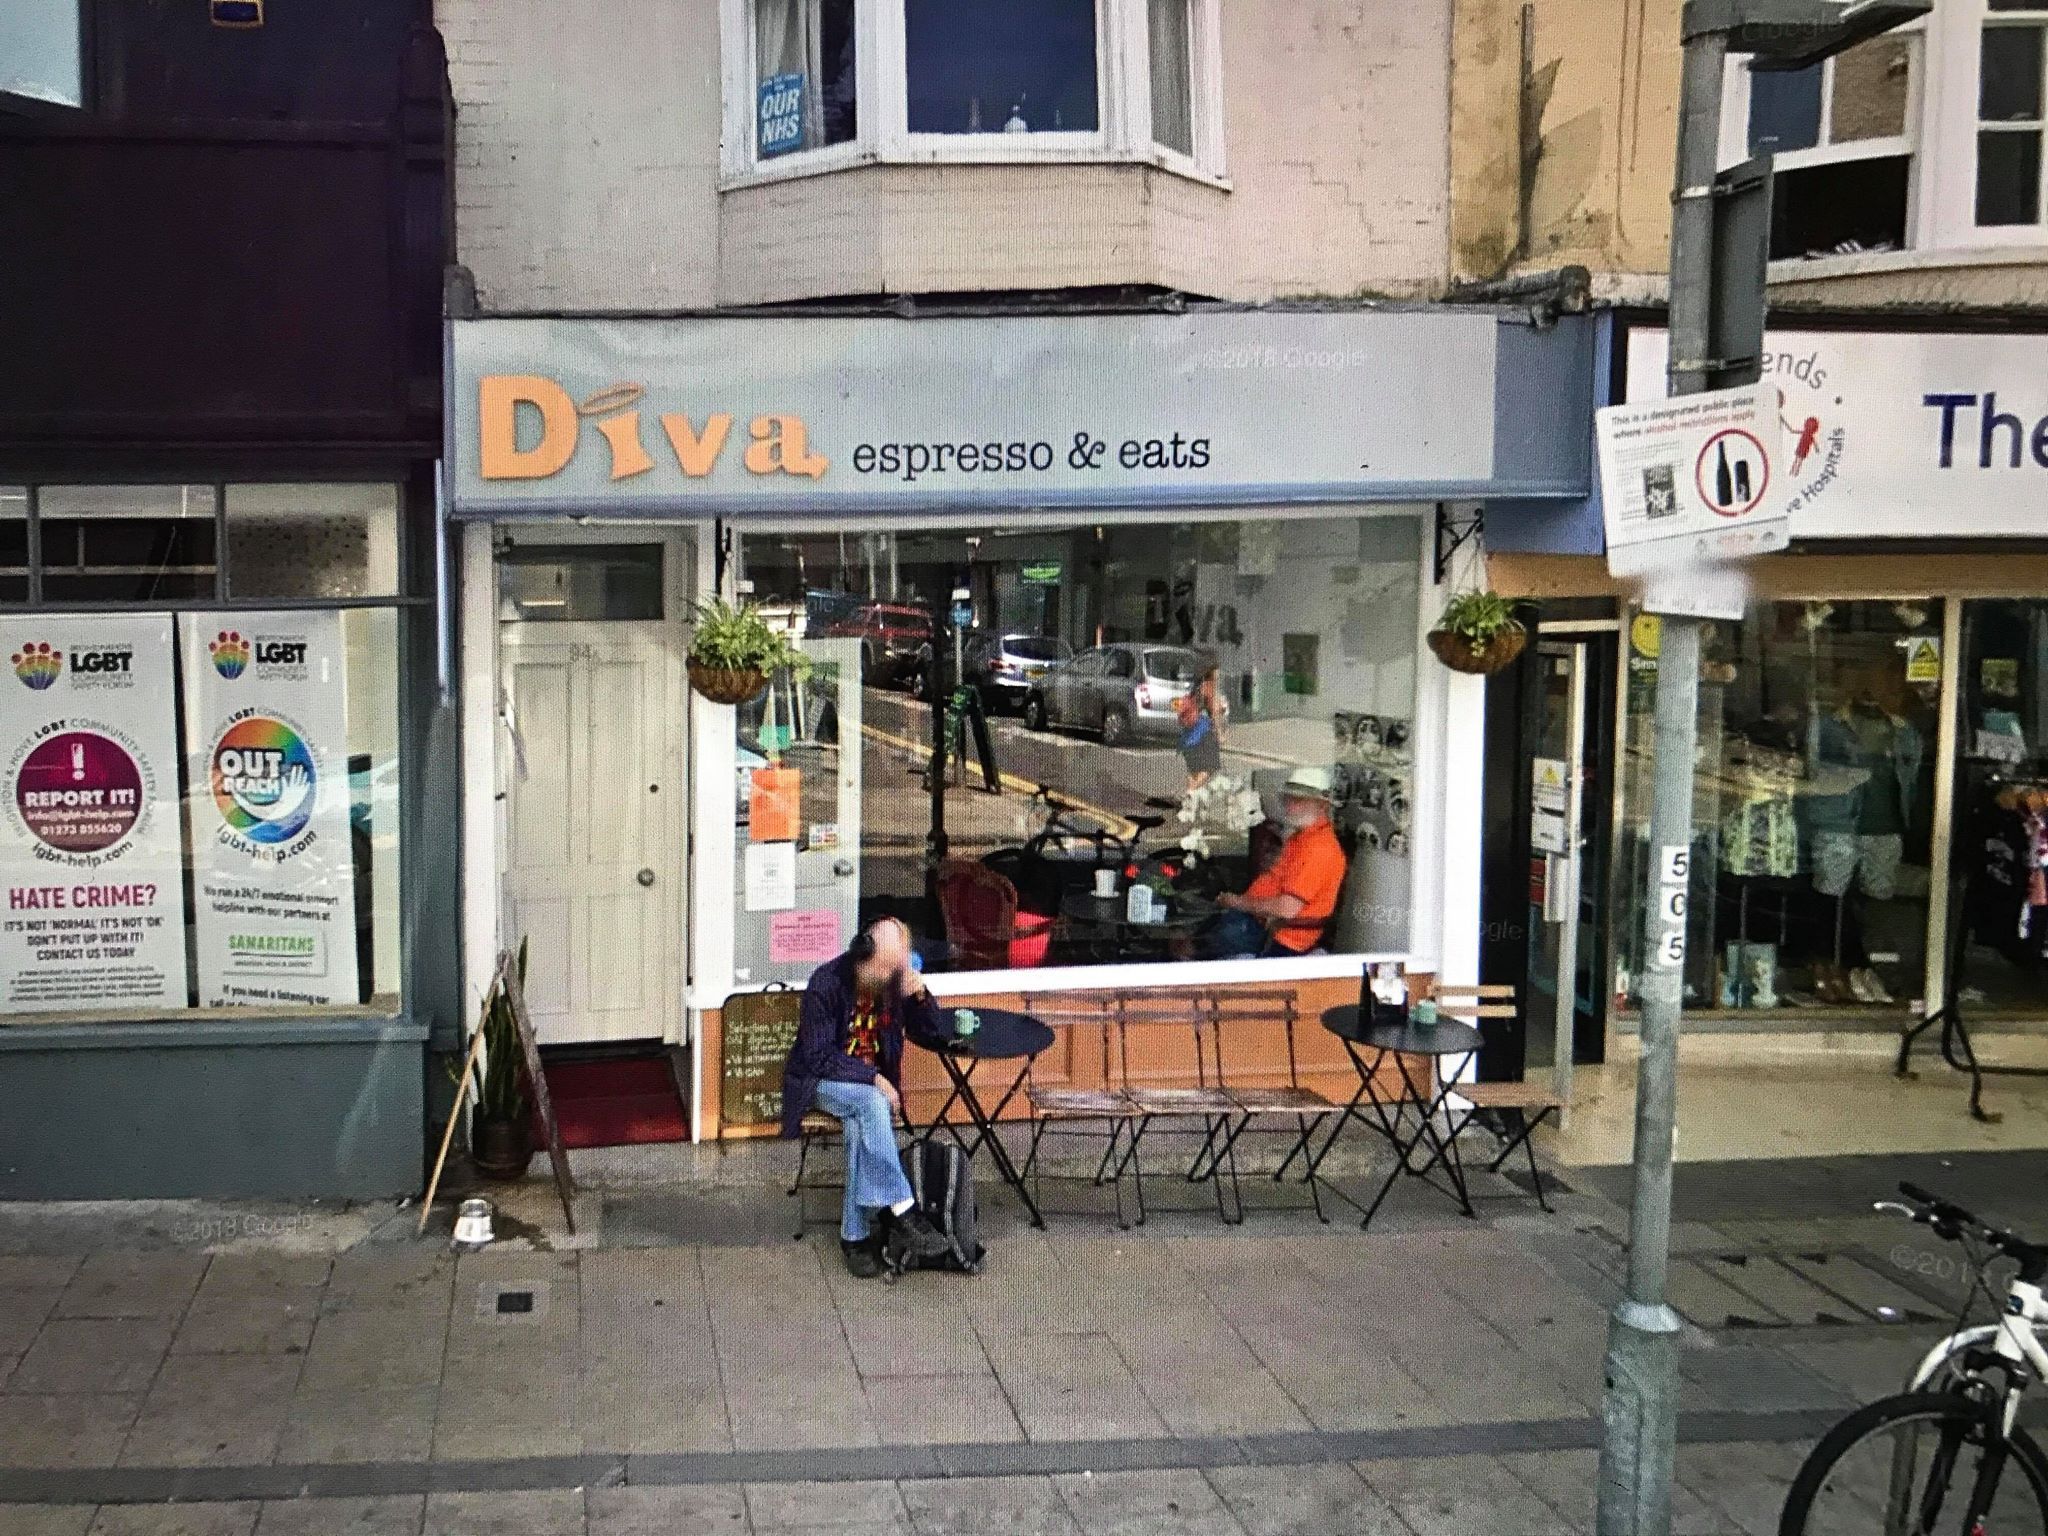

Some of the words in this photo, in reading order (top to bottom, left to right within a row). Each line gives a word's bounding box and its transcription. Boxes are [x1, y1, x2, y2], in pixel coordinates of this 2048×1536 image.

[761, 88, 800, 119] OUR
[762, 114, 800, 146] NHS
[1650, 404, 1700, 421] designated
[1702, 400, 1728, 413] public
[479, 374, 830, 481] Diva
[1613, 428, 1641, 439] where
[1645, 423, 1676, 434] alcohol
[1680, 414, 1729, 429] restrictions
[1731, 409, 1756, 423] apply
[852, 441, 1054, 481] espresso
[1068, 432, 1106, 470] &
[1118, 432, 1211, 469] eats
[1801, 427, 1845, 502] Hospitals
[70, 652, 133, 673] LGBT
[256, 643, 307, 664] LGBT
[229, 707, 255, 723] LGBT
[35, 719, 66, 739] LGBT
[219, 749, 283, 779] OUT
[25, 790, 104, 808] REPORT
[110, 788, 136, 805] IT!
[41, 824, 77, 836] 01273
[216, 822, 317, 864] lgbt-help.com
[32, 840, 134, 868] lgbt-help.com
[9, 887, 66, 909] HATE
[72, 884, 157, 908] CRIME?
[247, 905, 266, 914] with
[284, 909, 320, 921] partners
[27, 920, 47, 931] NOT
[100, 917, 118, 928] IT'S
[122, 917, 143, 927] NOT
[27, 934, 57, 946] DON'T
[60, 933, 80, 944] PUT
[84, 933, 98, 944] UP
[100, 932, 129, 943] WITH
[130, 932, 145, 942] IT!
[228, 934, 315, 951] SAMARITANS
[36, 948, 83, 961] CONTACT
[86, 948, 100, 958] US
[103, 947, 136, 958] TODAY
[248, 987, 269, 998] need
